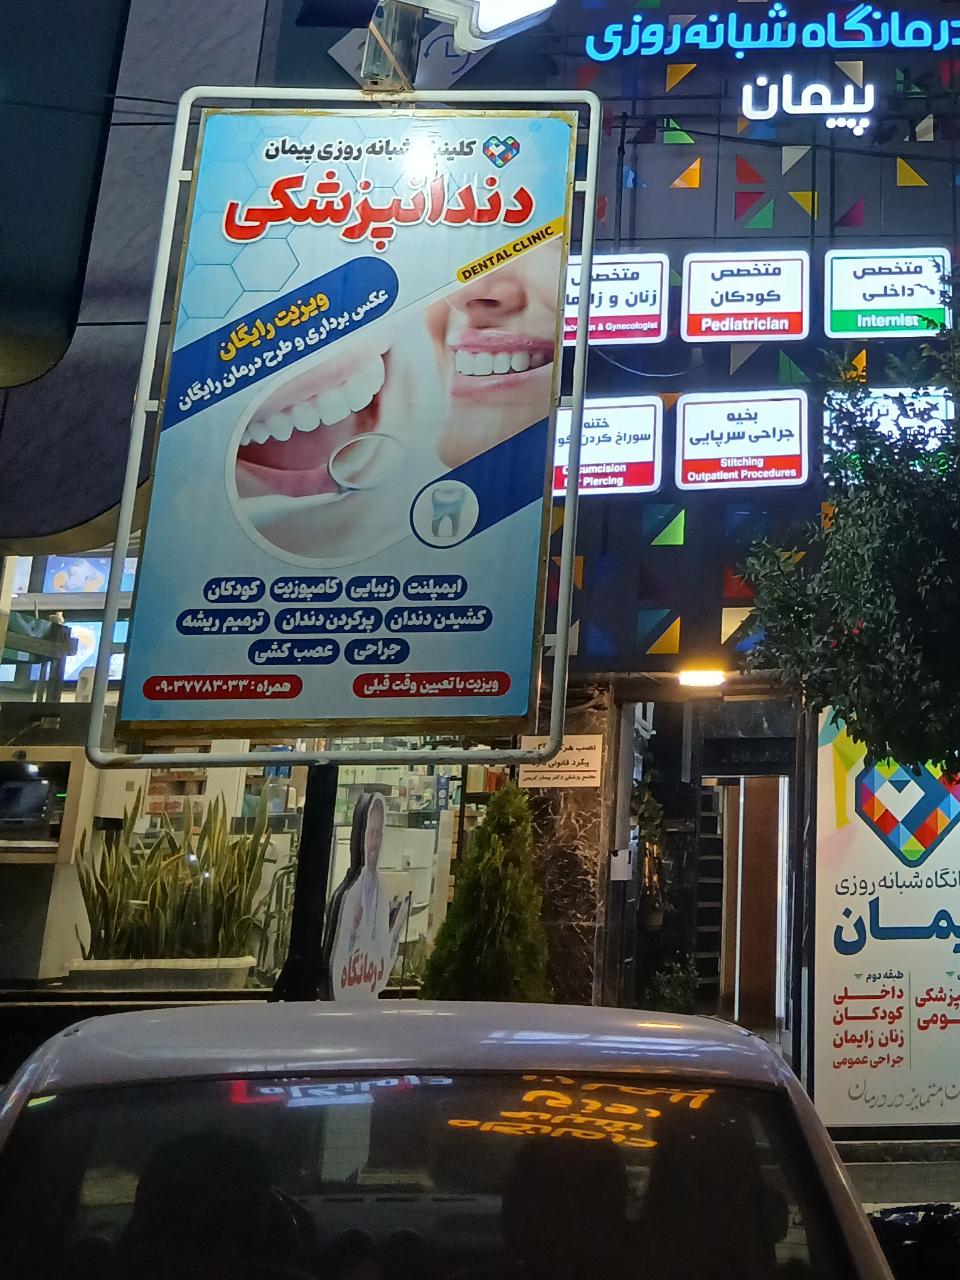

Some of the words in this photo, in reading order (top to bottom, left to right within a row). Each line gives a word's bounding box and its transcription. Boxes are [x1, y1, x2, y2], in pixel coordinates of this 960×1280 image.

[585, 13, 681, 62] روزی
[685, 2, 796, 60] شبانه
[741, 73, 875, 137] پیمان
[264, 138, 315, 164] پیمان
[317, 140, 363, 161] روزی
[224, 170, 534, 251] دندانپزشکی
[461, 249, 512, 280] DENTAL
[513, 226, 554, 253] CLINIC
[711, 264, 782, 280] متخصص
[853, 261, 923, 279] متخصص
[609, 294, 619, 307] و
[625, 289, 657, 307] زنان
[711, 290, 781, 307] کودکان
[862, 285, 914, 302] داخلی
[274, 293, 330, 327] ویزیت
[351, 289, 389, 320] عکس
[305, 311, 350, 345] برداری
[605, 320, 658, 332] Gynecologist
[701, 316, 789, 332] Pediatrician
[857, 313, 920, 328] Internist
[219, 319, 275, 361] رایگان
[294, 337, 305, 351] و
[263, 340, 292, 367] طرح
[223, 356, 262, 387] درمان
[178, 378, 222, 411] رایگان
[583, 417, 609, 429] ختنه
[726, 409, 758, 425] بخیه
[616, 431, 651, 445] سوراخ
[689, 428, 745, 447] سرپایی
[748, 427, 795, 445] جراحی
[720, 457, 764, 469] Stitching
[583, 475, 624, 487] Piercing
[687, 470, 739, 483] Outpatient
[741, 468, 797, 481] Procedures
[207, 579, 260, 600] کودکان
[273, 578, 339, 601] کامپوزیت
[351, 578, 396, 599] زیبایی
[407, 578, 462, 601] ایمپلنت
[182, 610, 219, 632] ریشه
[222, 611, 264, 633] ترمیم
[282, 611, 323, 630] دندان
[390, 610, 430, 630] دندان
[434, 607, 487, 629] کشیدن
[254, 641, 291, 663] کشی
[294, 642, 334, 662] عصب
[354, 639, 401, 661] جراحی
[363, 674, 390, 695] قبلی
[392, 674, 417, 693] وقت
[465, 677, 499, 693] ویزیت
[835, 874, 876, 896] روزی
[878, 871, 923, 895] شبانه
[340, 947, 385, 993] درمانگاه
[866, 972, 882, 983] دوم
[882, 969, 904, 981] طبقه
[833, 984, 904, 1005] داخلی
[832, 1006, 904, 1026] کودکان
[832, 1029, 874, 1049] زایمان
[878, 1028, 904, 1048] زنان
[832, 1055, 868, 1069] عمومی
[869, 1053, 904, 1069] جراحی
